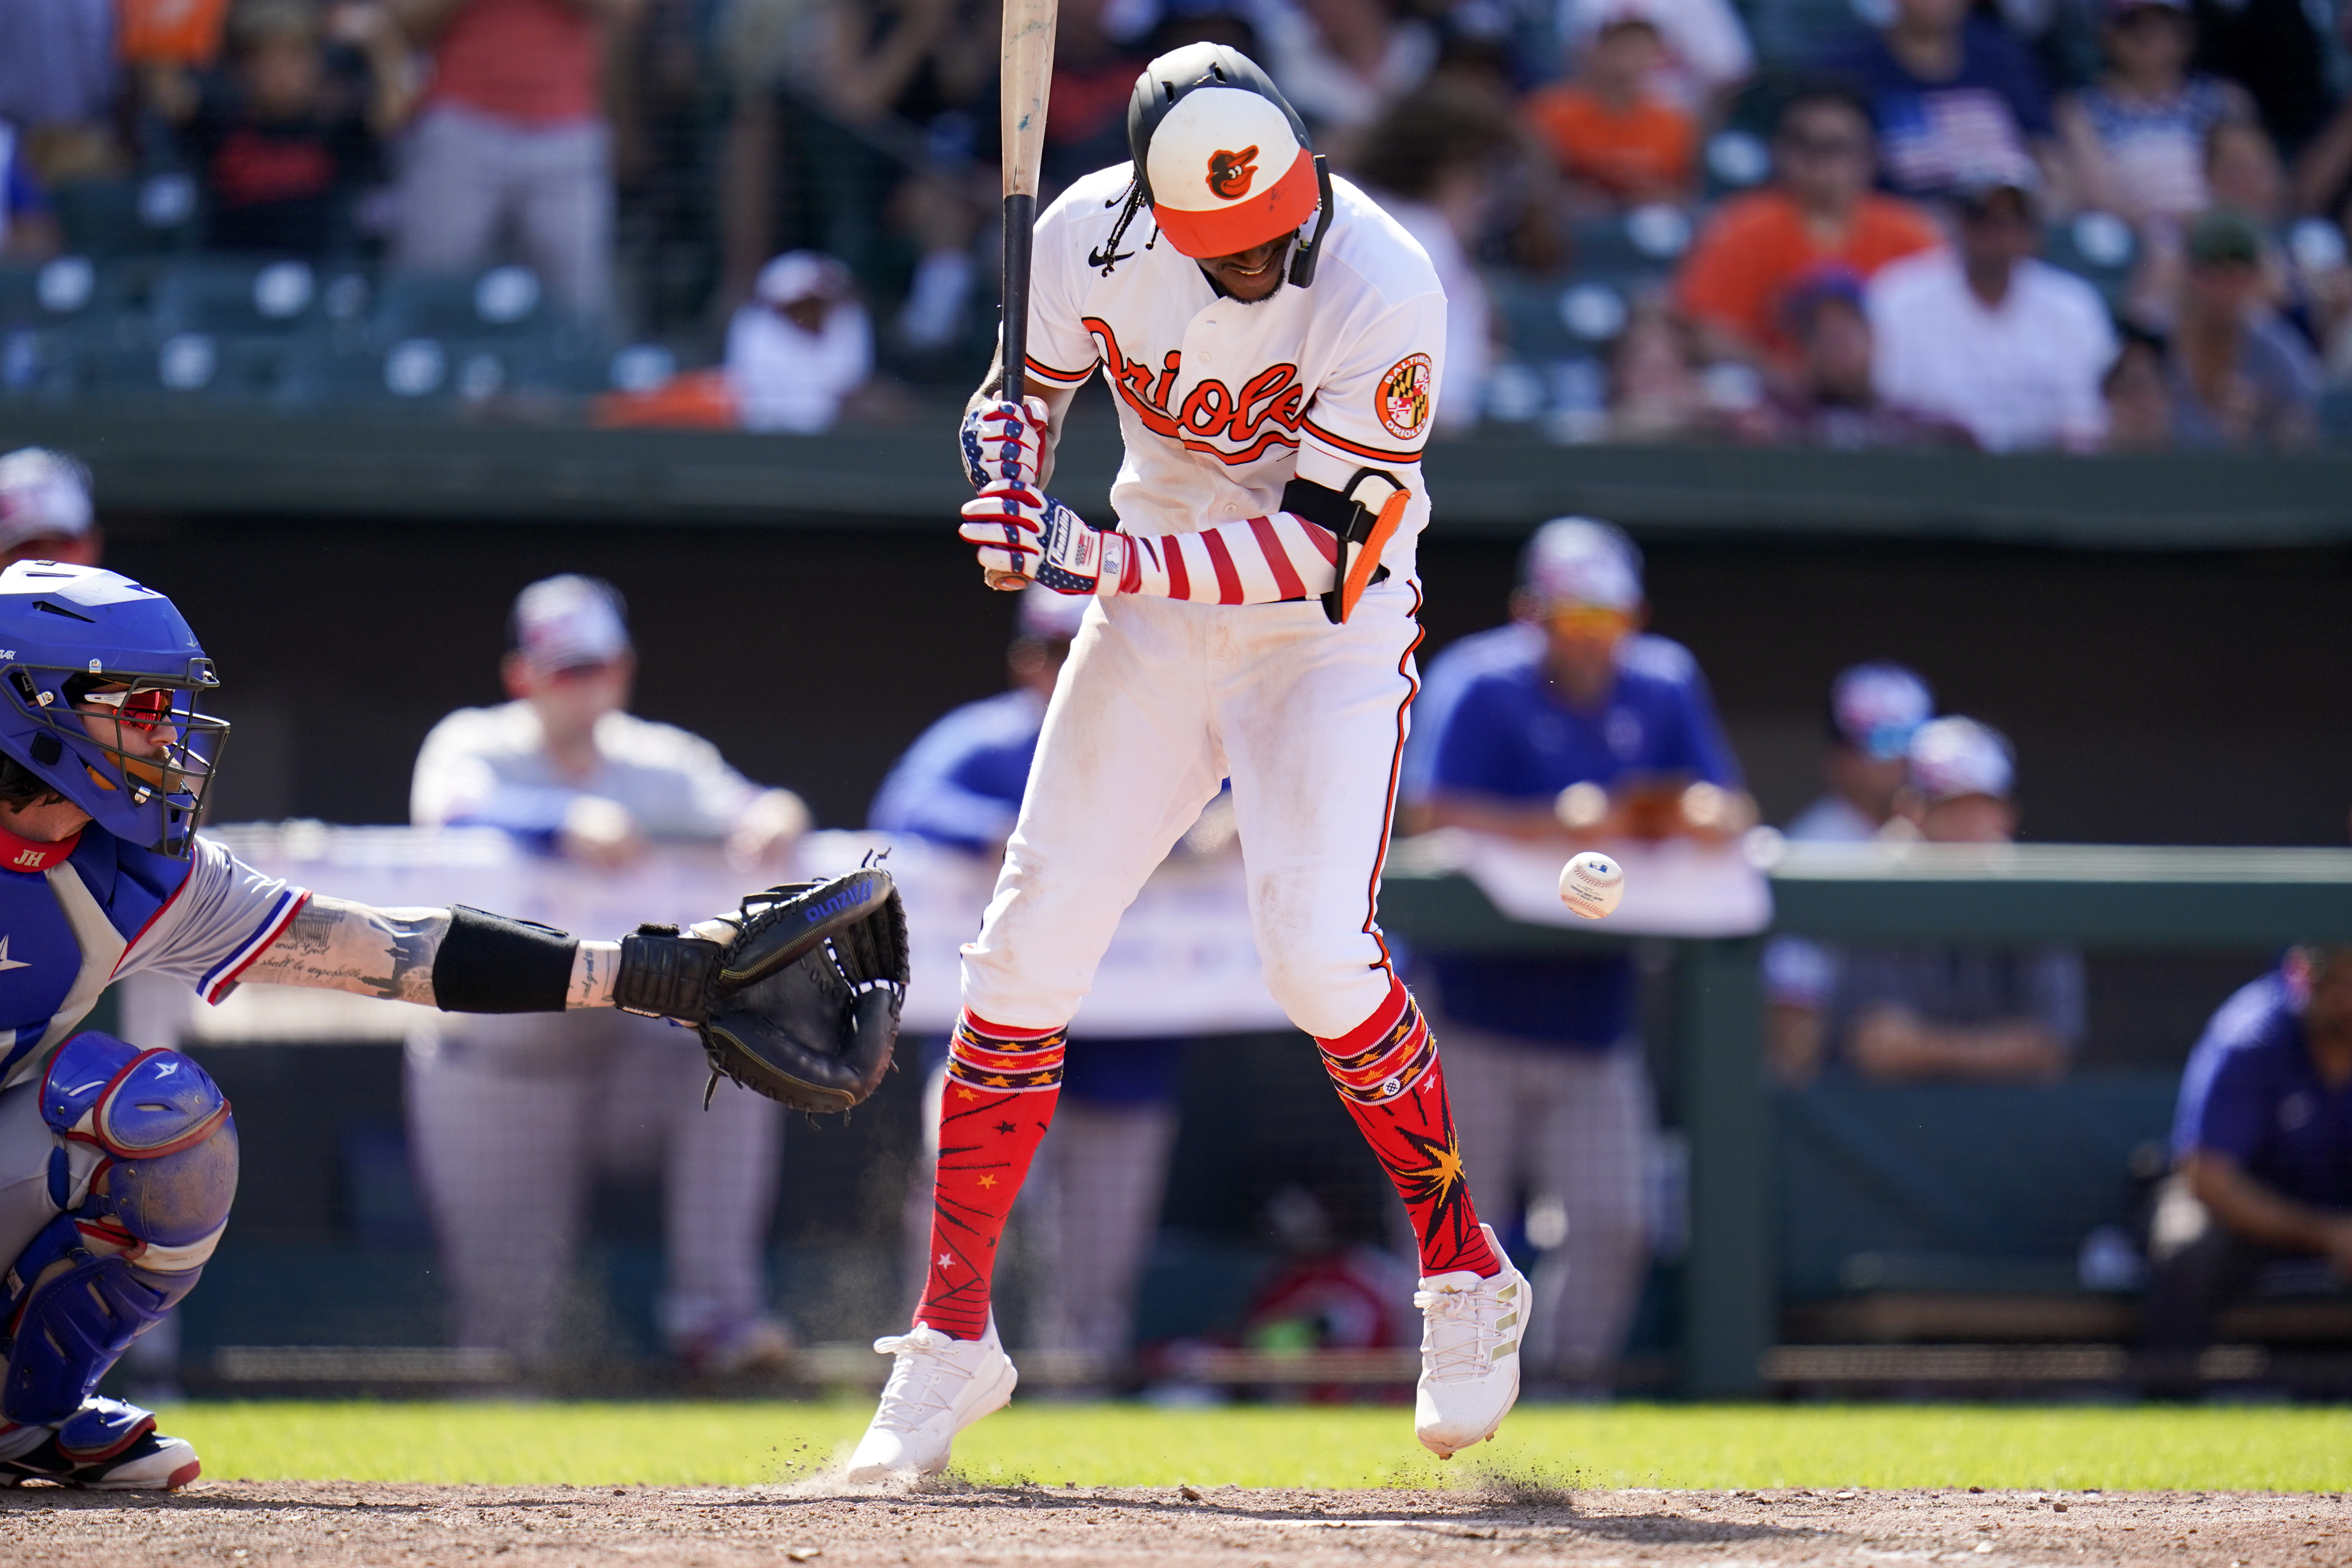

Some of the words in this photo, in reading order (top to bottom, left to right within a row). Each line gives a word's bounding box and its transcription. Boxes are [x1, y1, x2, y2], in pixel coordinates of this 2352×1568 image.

[1082, 317, 1305, 442] Oriole
[1386, 417, 1427, 438] ORIOLES
[0, 649, 14, 660] TAR
[13, 850, 46, 867] JH
